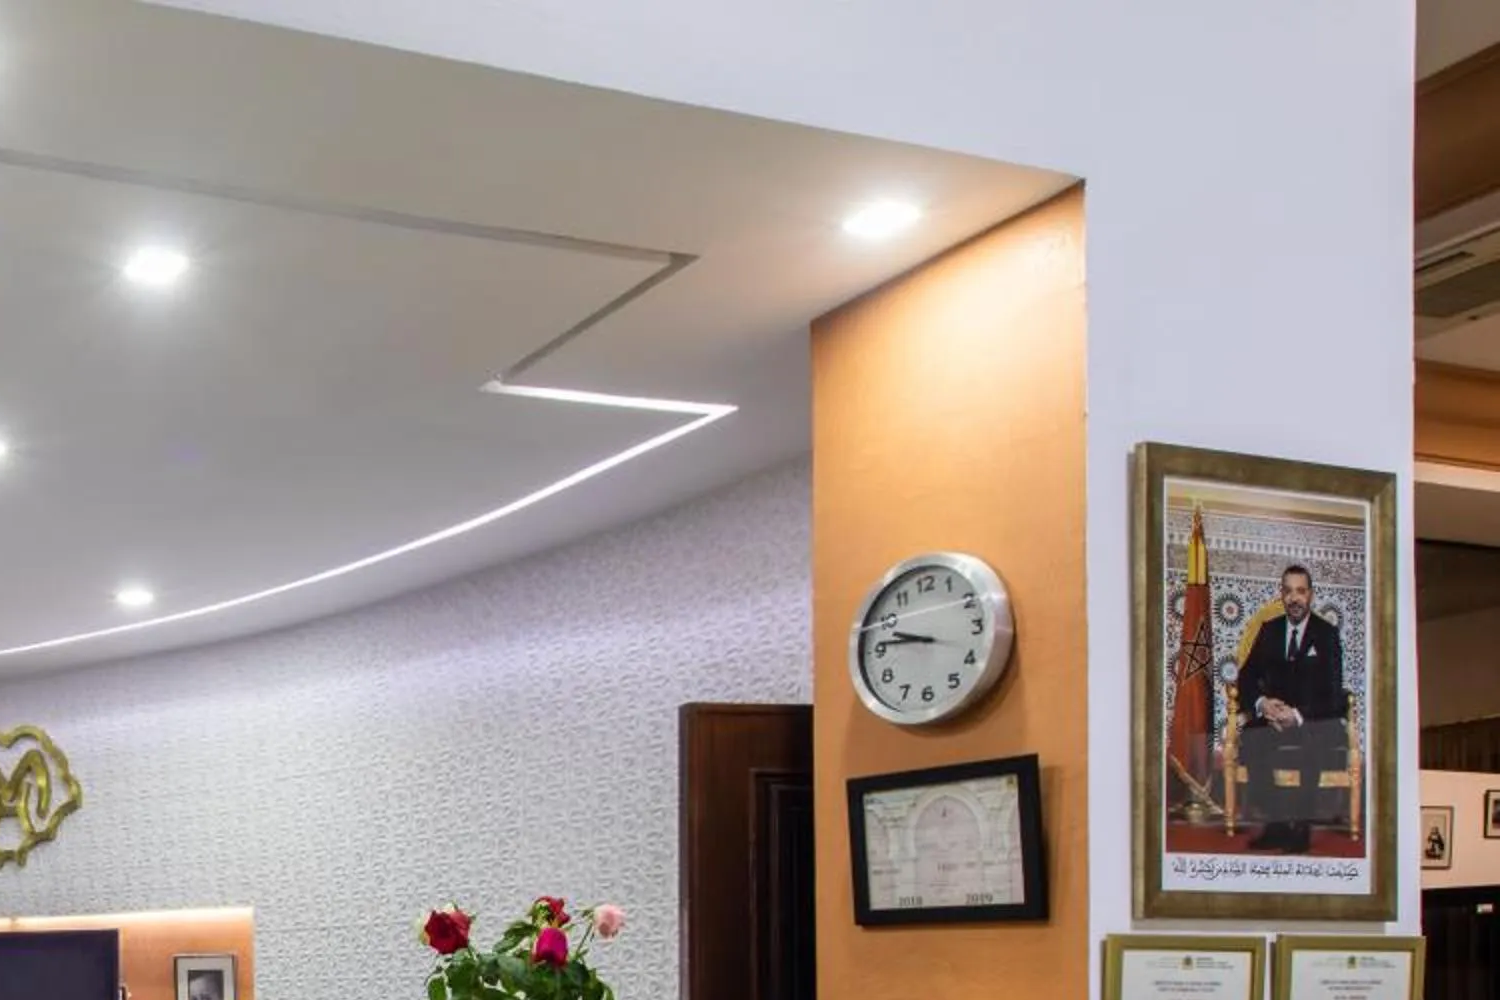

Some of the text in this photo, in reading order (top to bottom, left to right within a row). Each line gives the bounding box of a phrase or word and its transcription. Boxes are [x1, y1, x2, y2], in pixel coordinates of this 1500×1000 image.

[916, 575, 935, 593] 12
[945, 576, 953, 593] 1
[896, 590, 909, 607] 11
[962, 592, 977, 609] 2
[880, 612, 898, 630] 10
[971, 618, 983, 635] 3
[874, 643, 887, 659] 9
[963, 649, 976, 665] 4
[881, 668, 895, 684] 8
[947, 672, 960, 689] 5
[899, 684, 911, 701] 7
[921, 685, 935, 702] 6
